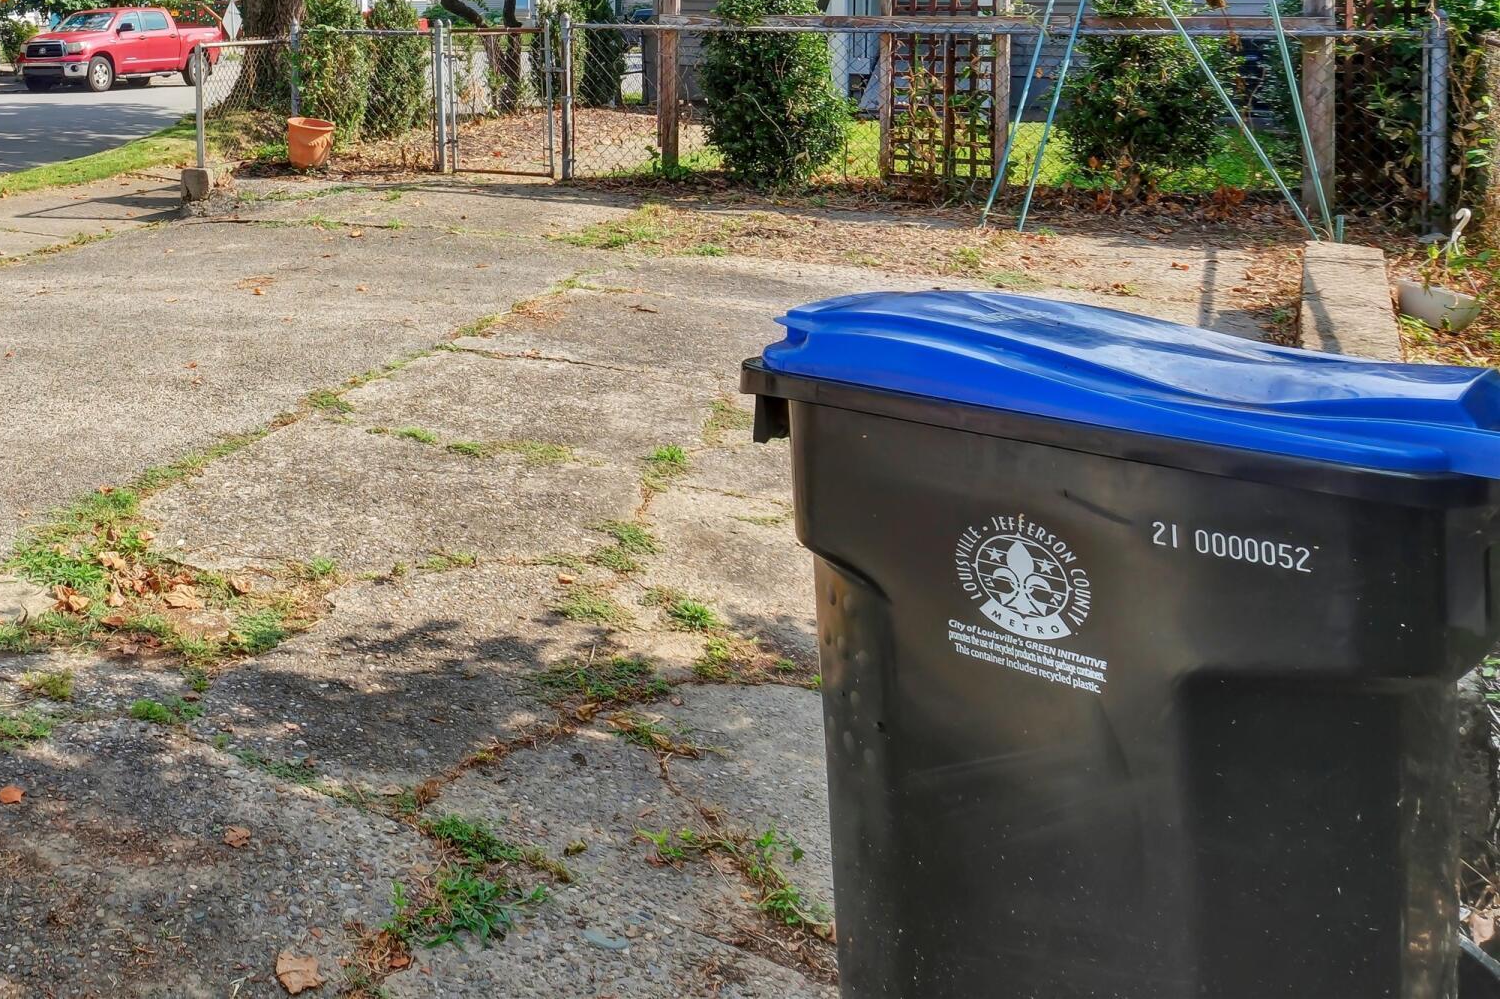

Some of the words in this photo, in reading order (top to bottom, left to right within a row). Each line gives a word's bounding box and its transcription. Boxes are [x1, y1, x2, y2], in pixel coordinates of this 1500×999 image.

[955, 526, 983, 600] LOUISVILLE
[991, 515, 1077, 563] JEFFERSON
[1068, 568, 1092, 626] COUNTY
[1195, 529, 1312, 573] 0000052
[948, 619, 966, 632] City
[967, 625, 977, 633] of
[977, 626, 1024, 647] Louisville's
[1025, 640, 1056, 656] GREEN
[1057, 649, 1108, 670] INITIATIVE
[991, 610, 1060, 635] METRO
[954, 642, 970, 655] This
[971, 649, 1005, 665] container
[1006, 657, 1037, 675] includes
[1039, 668, 1071, 685] recycled
